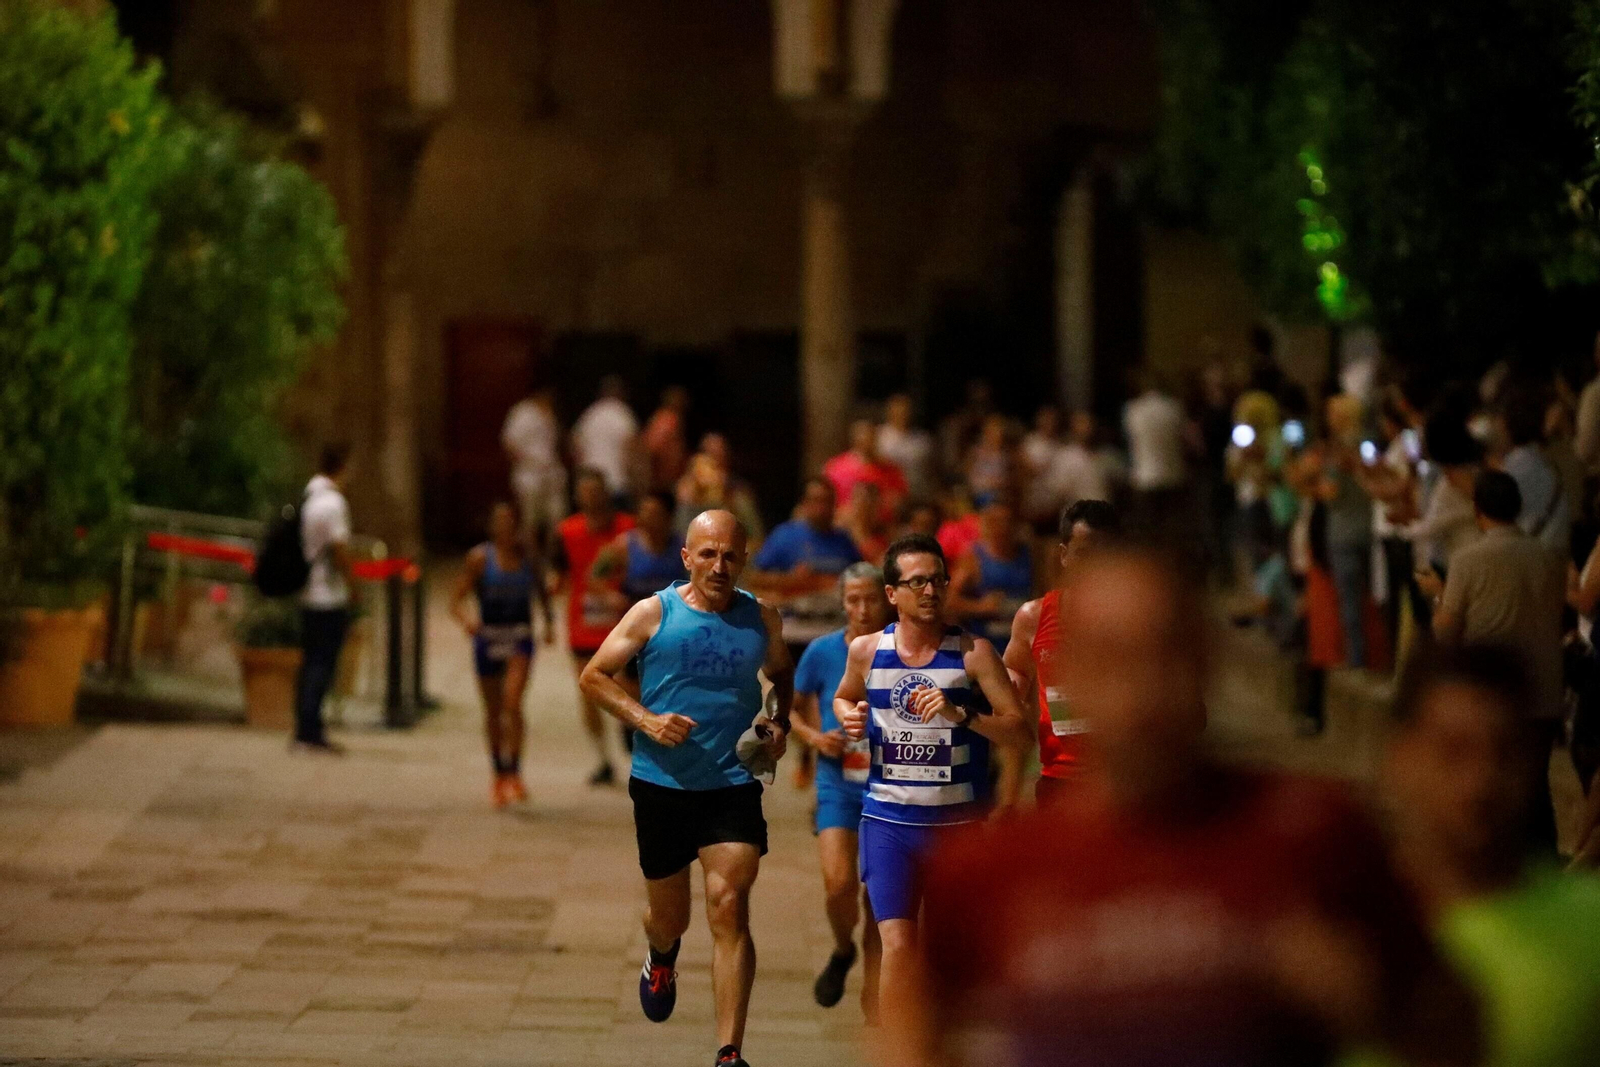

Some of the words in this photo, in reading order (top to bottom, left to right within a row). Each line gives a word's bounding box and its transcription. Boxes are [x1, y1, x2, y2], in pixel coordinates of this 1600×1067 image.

[893, 679, 909, 708] PENYA
[911, 675, 934, 689] RUNN
[899, 711, 922, 722] ESPAN
[900, 731, 913, 742] 20
[895, 745, 936, 761] 1099
